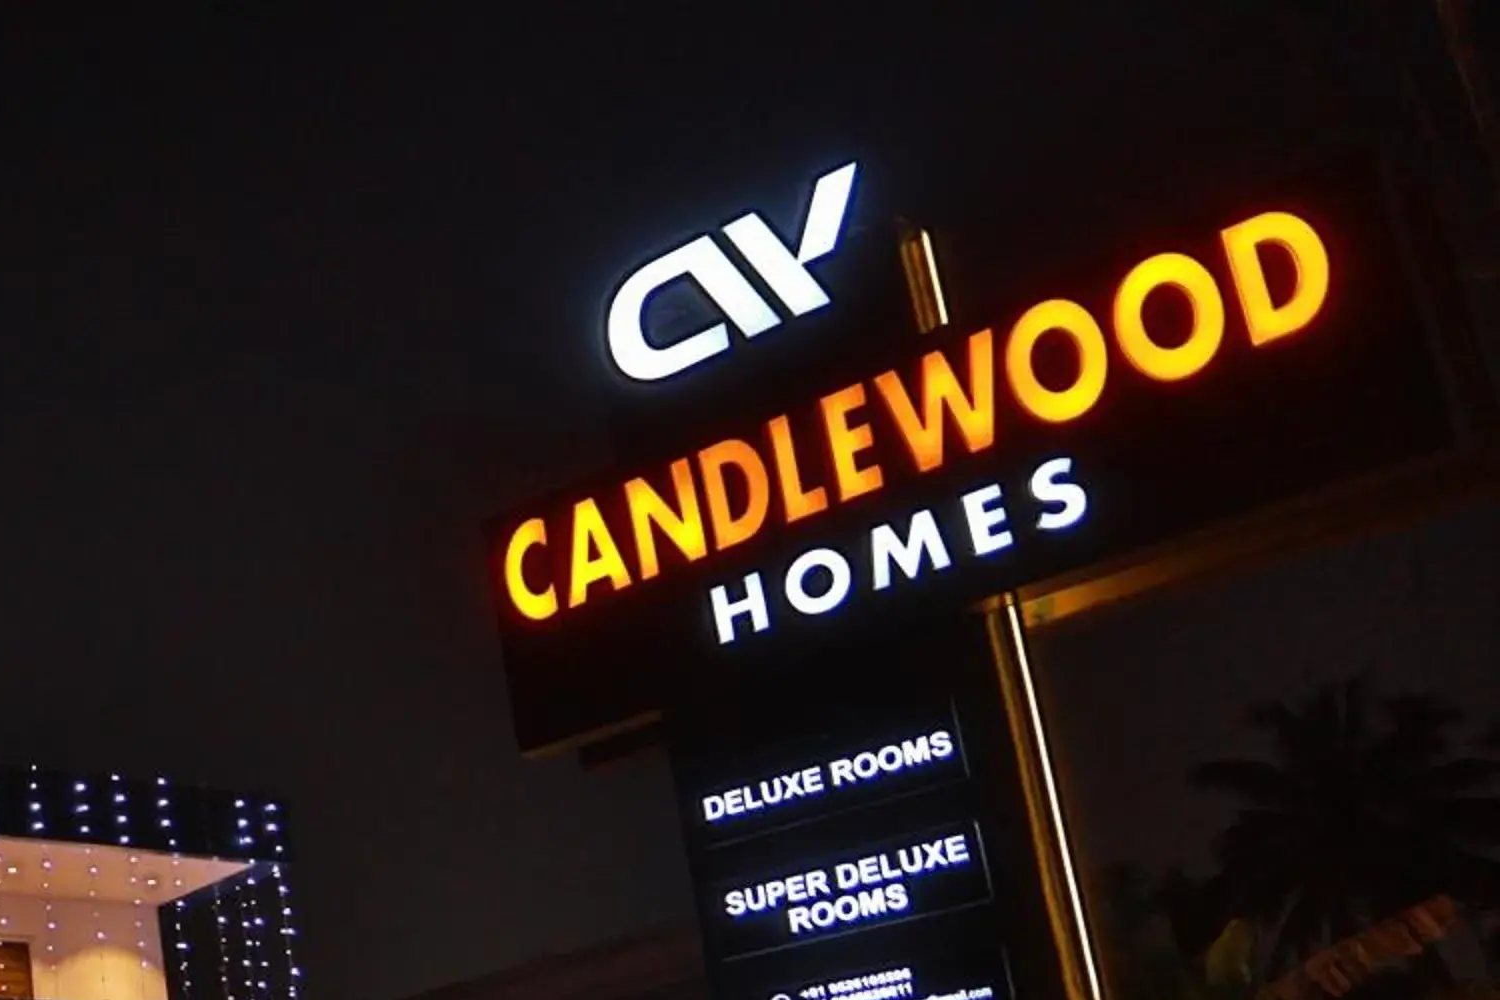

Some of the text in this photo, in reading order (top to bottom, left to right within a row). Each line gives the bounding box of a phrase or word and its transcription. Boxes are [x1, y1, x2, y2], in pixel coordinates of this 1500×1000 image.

[506, 212, 1328, 619] CANDLEWOOD
[711, 458, 1086, 644] HOMES
[703, 732, 952, 820] DELUXE ROOMS
[726, 835, 968, 914] SUPER DELUXE
[788, 884, 908, 932] ROOMS
